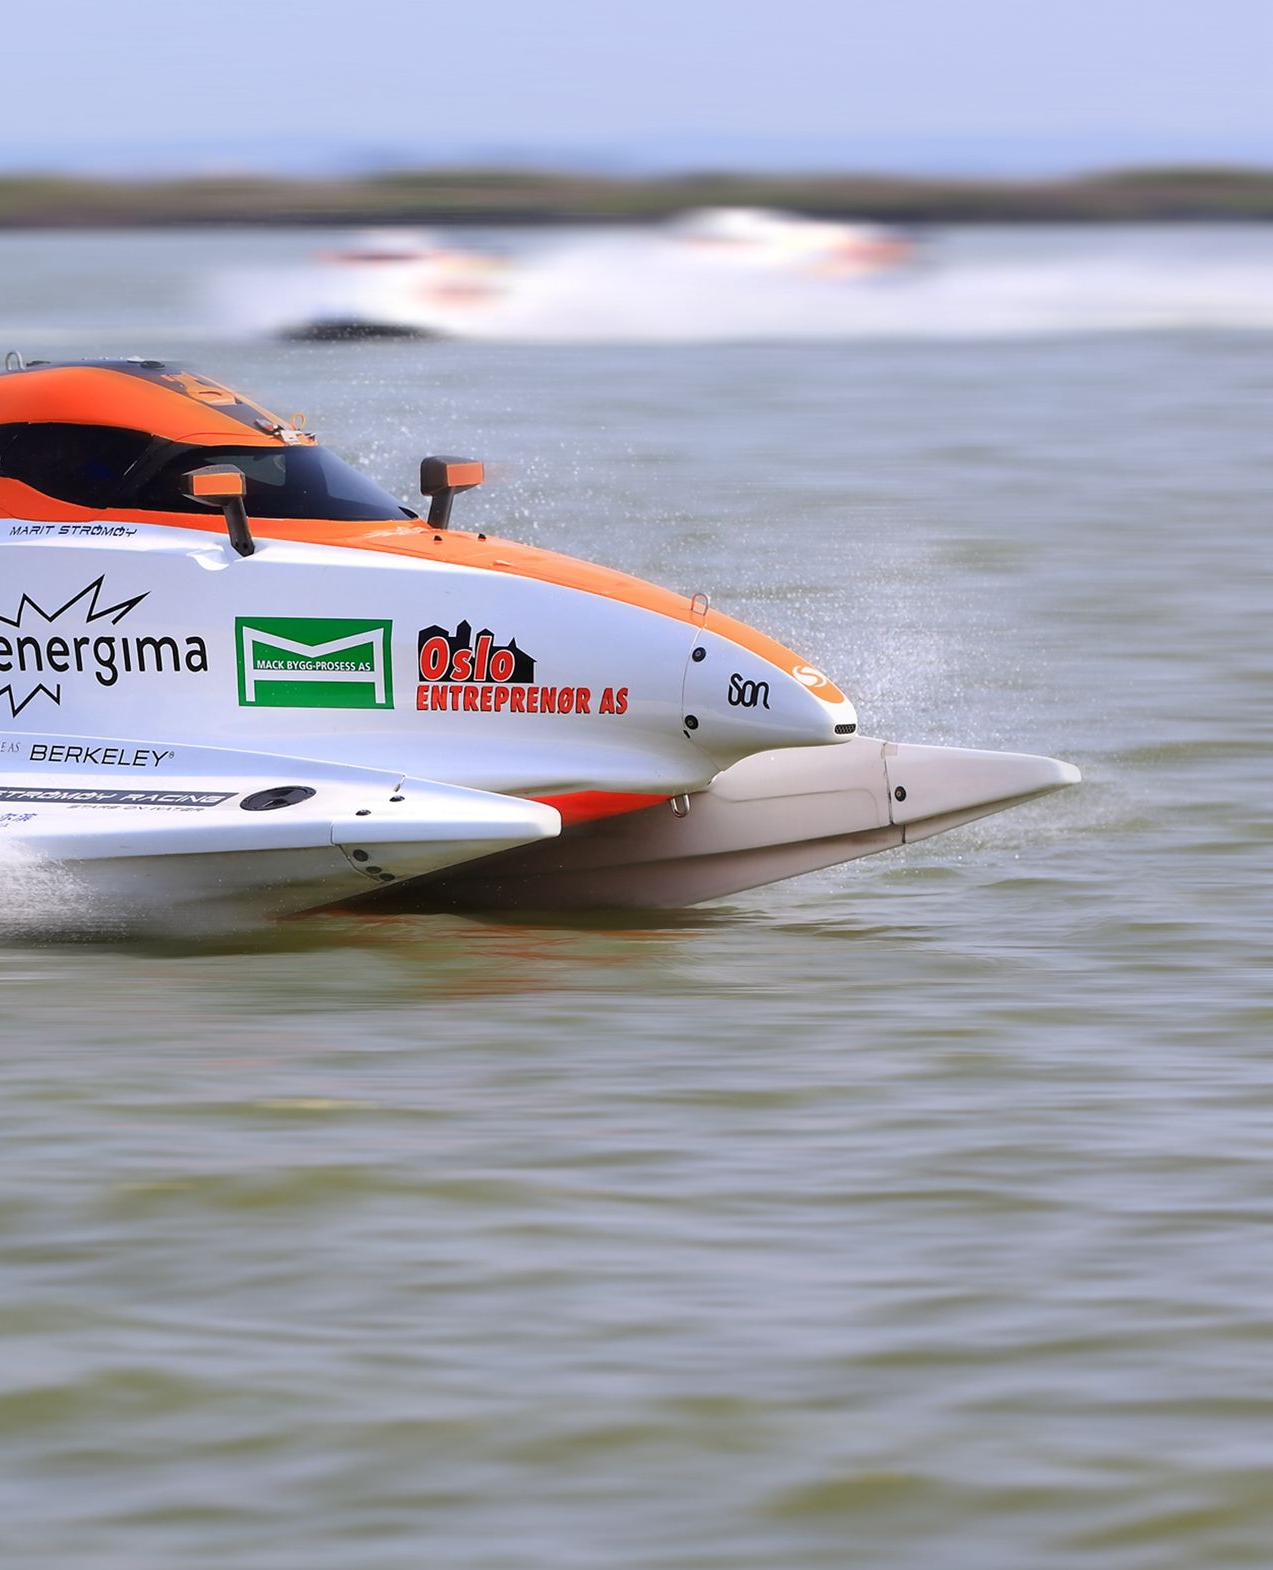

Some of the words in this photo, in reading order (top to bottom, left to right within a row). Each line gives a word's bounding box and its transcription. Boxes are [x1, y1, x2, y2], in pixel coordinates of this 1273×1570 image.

[9, 525, 55, 536] MARIT
[419, 635, 516, 683] Oslo
[256, 660, 285, 670] MACK
[286, 661, 356, 671] BYGG-PROSESS
[358, 662, 371, 672] AS
[416, 685, 592, 715] ENTREPRENØR
[598, 687, 629, 715] AS
[7, 742, 21, 753] AS
[118, 792, 227, 804] RACING
